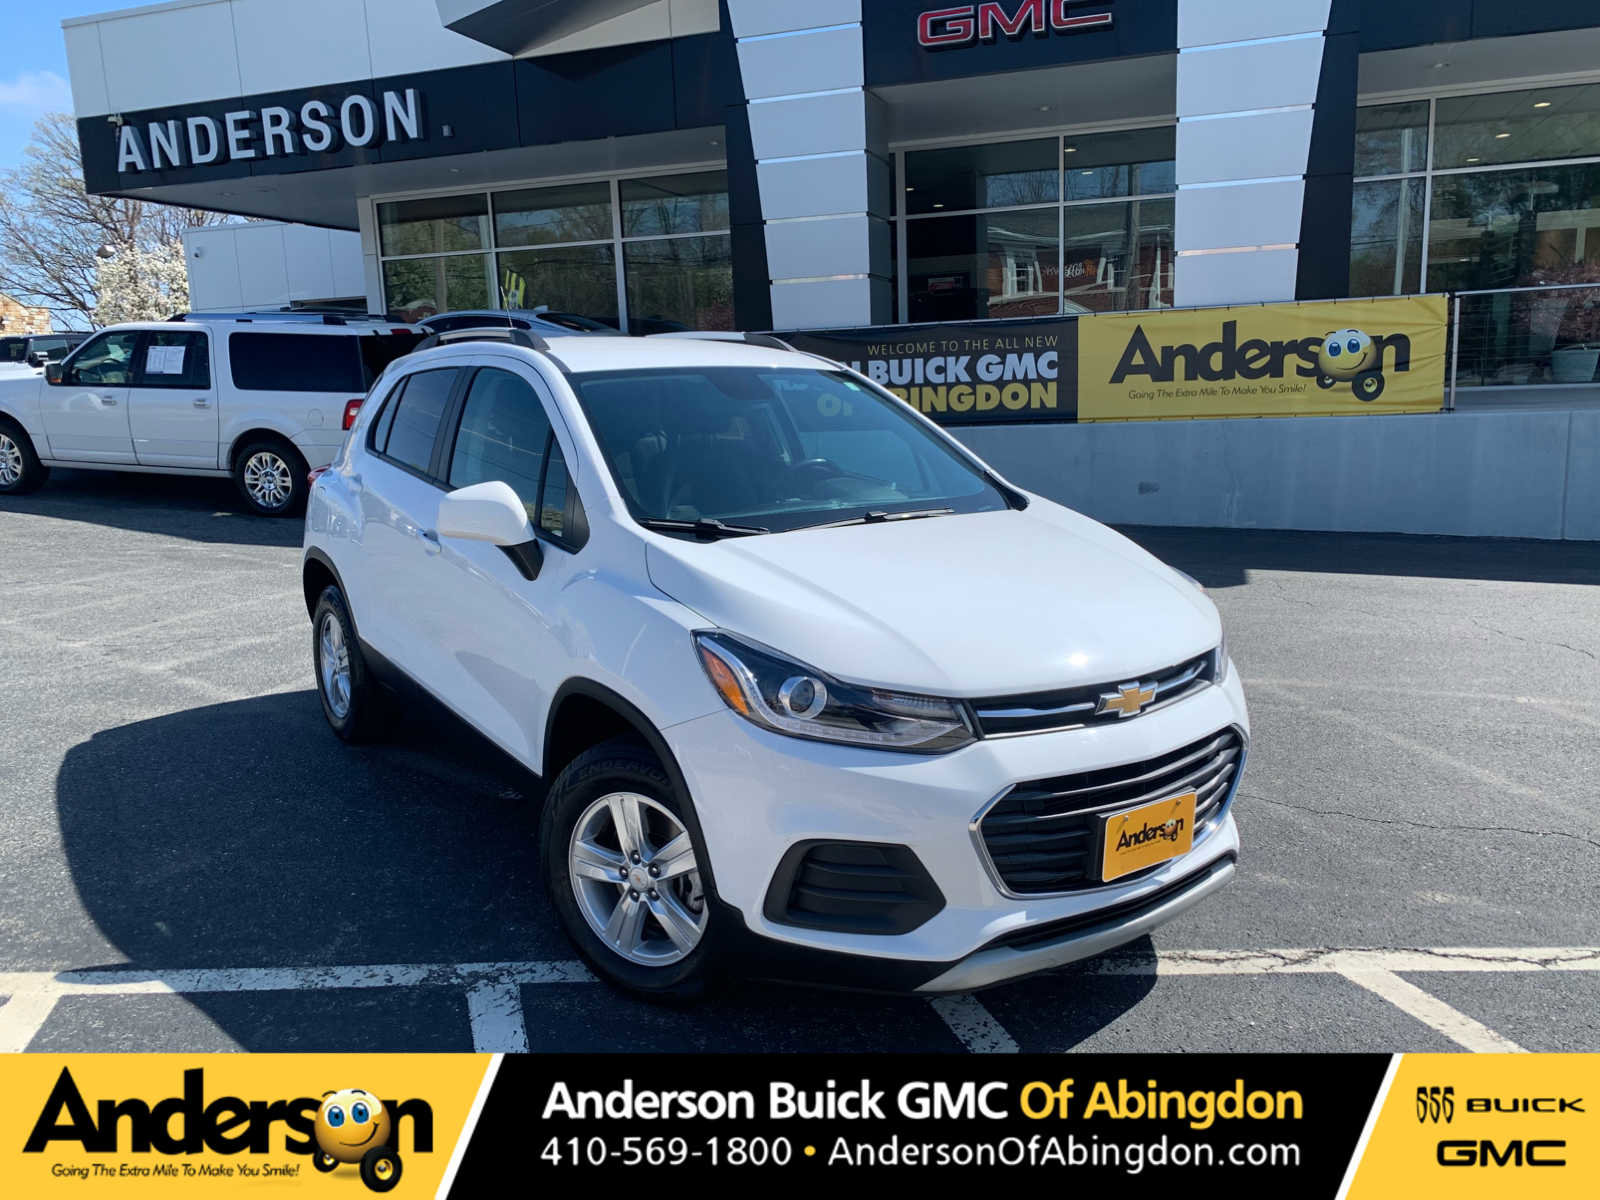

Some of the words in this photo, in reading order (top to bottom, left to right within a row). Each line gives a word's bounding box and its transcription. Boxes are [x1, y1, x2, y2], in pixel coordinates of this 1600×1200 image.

[917, 0, 1112, 46] GMC
[117, 88, 419, 172] ANDERSON
[867, 342, 936, 356] WELCOME
[942, 340, 959, 353] TO
[964, 339, 989, 351] THE
[995, 337, 1020, 349] ALL
[1025, 335, 1058, 348] NEW
[868, 355, 972, 386] BUICK
[976, 351, 1059, 382] GMC
[1128, 389, 1155, 400] Going
[1157, 389, 1174, 398] The
[1176, 388, 1198, 398] Extra
[1199, 387, 1218, 397] Mile
[1220, 386, 1231, 396] To
[1232, 386, 1257, 395] Make
[1259, 384, 1277, 394] You
[1278, 383, 1307, 393] Smile!
